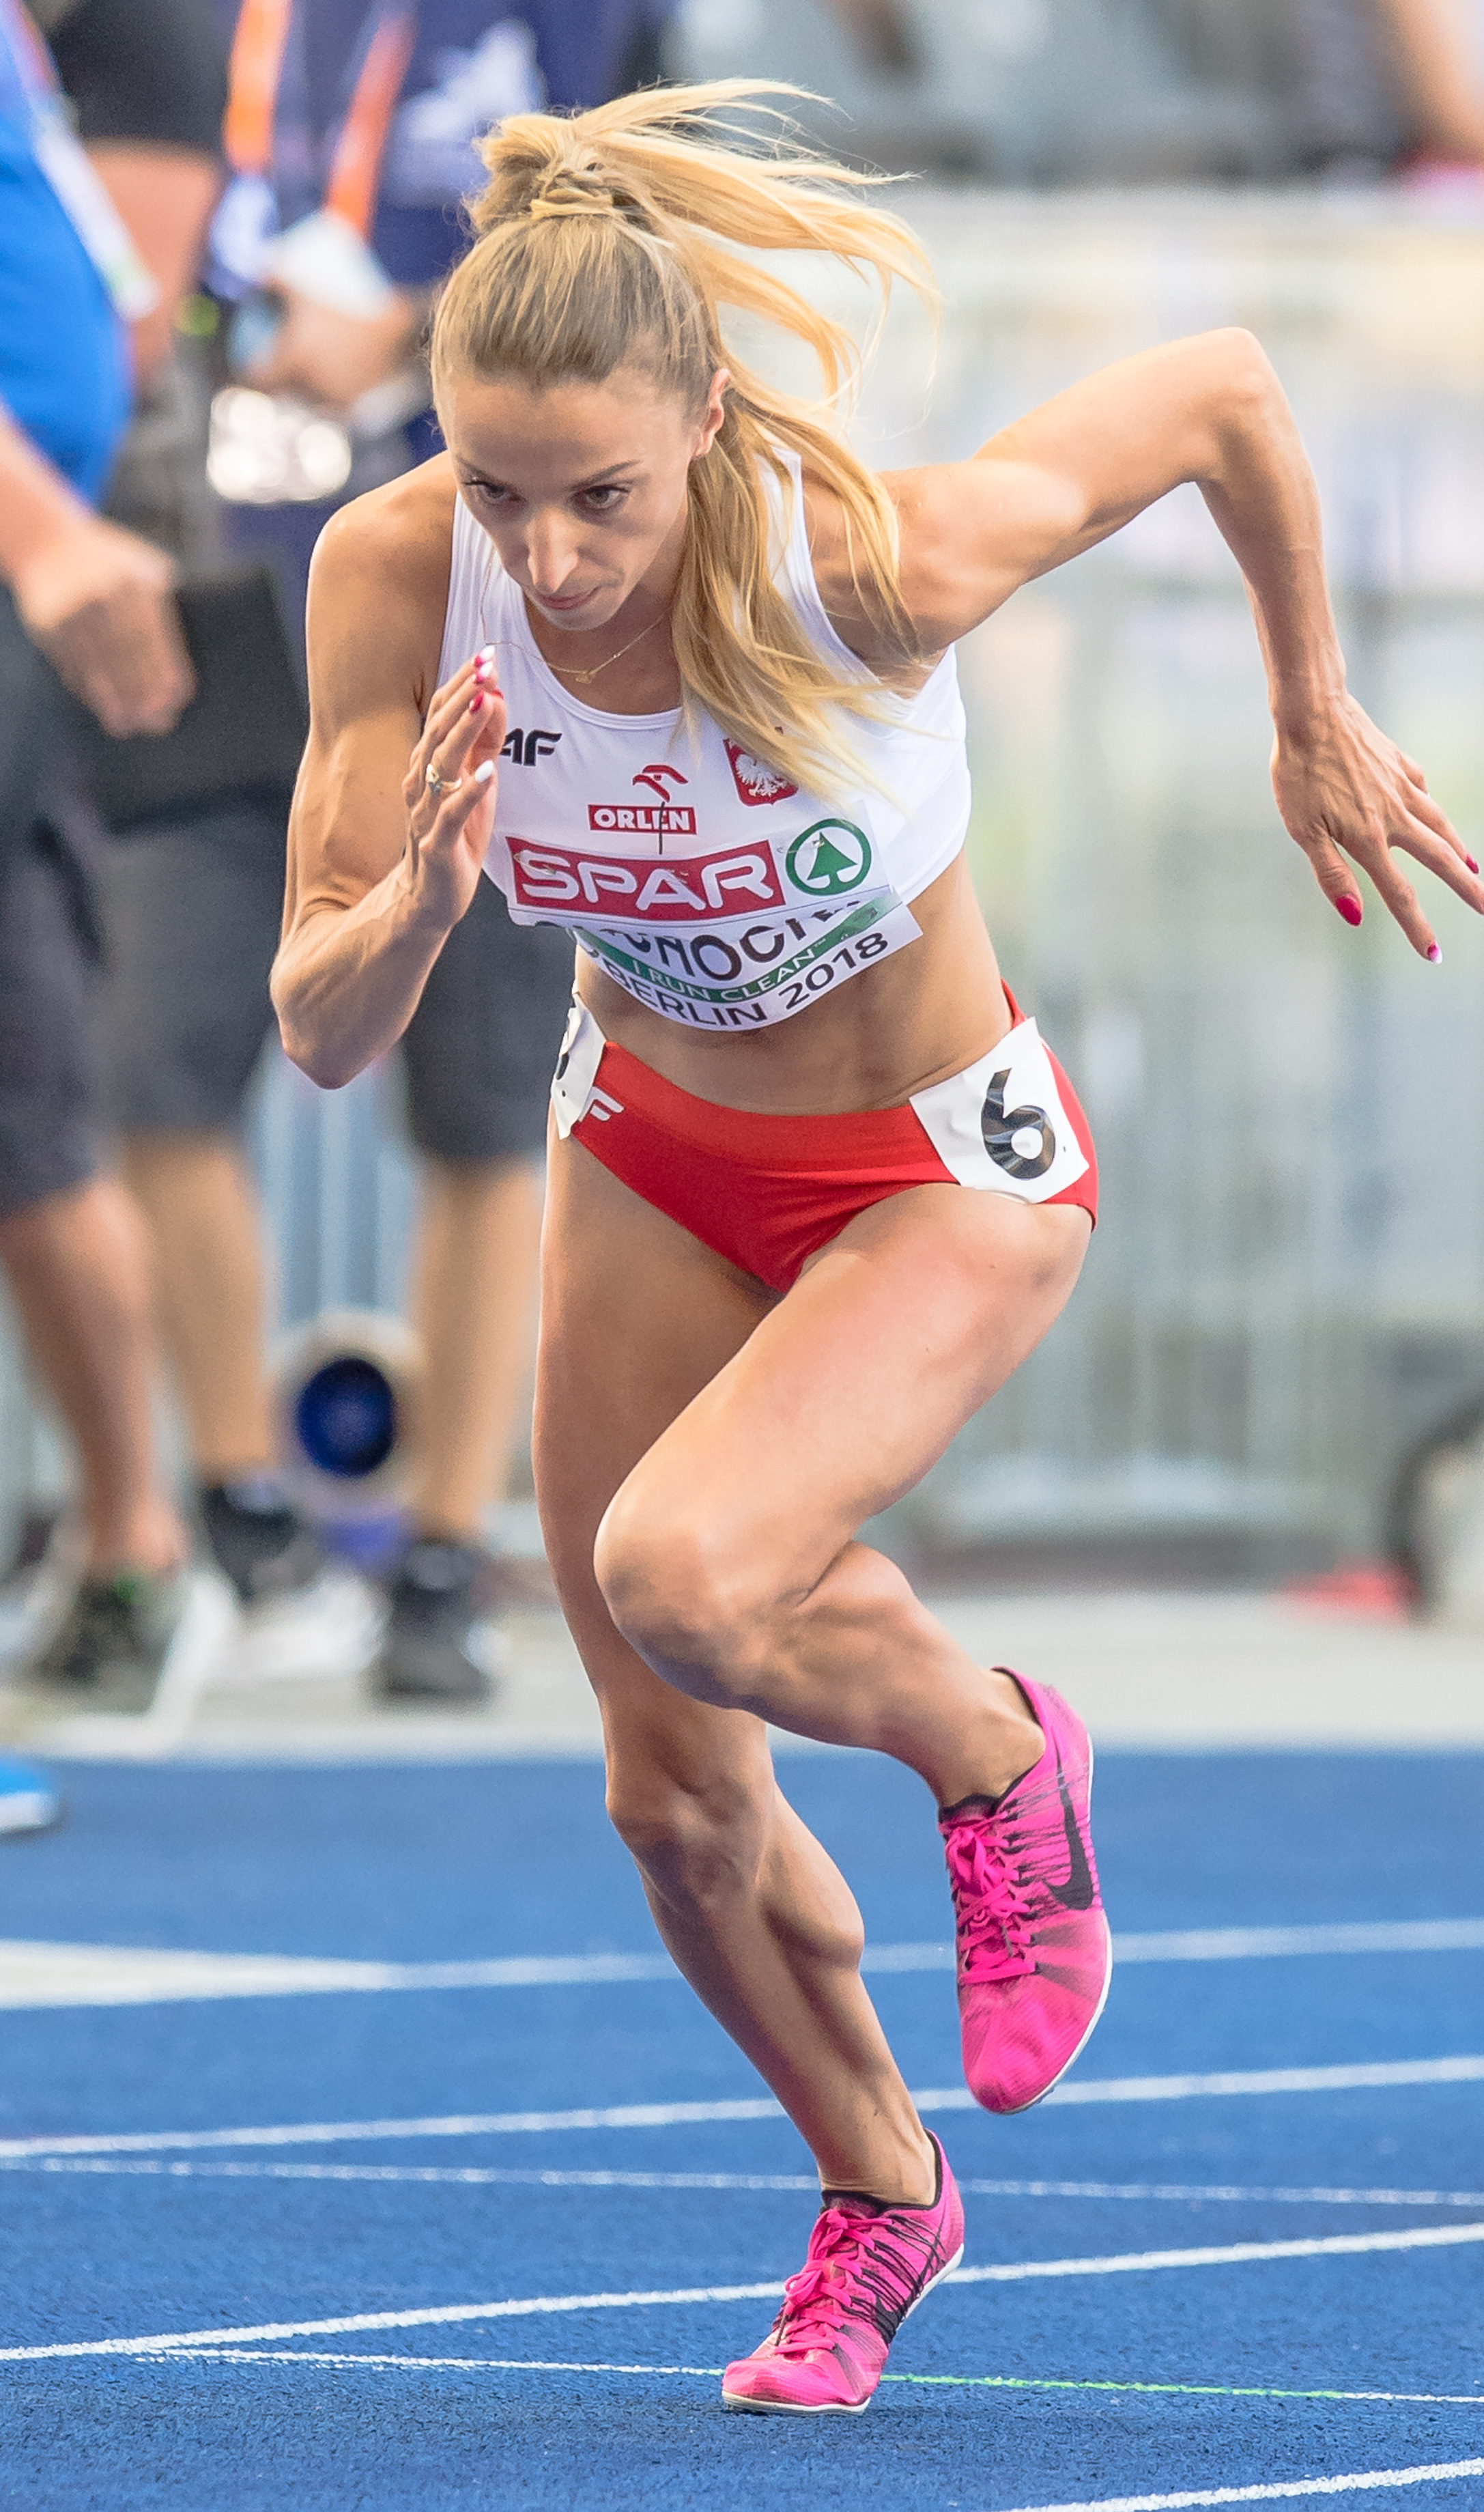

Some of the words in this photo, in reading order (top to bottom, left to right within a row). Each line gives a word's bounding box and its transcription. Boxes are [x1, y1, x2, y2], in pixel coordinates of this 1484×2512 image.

[593, 808, 690, 830] ORLEN
[520, 849, 774, 911] SPAR
[601, 957, 768, 1026] BERLIN
[778, 932, 888, 1010] 2018
[632, 959, 640, 975] I
[648, 968, 711, 1000] RUN
[721, 948, 815, 1002] CLEAN
[981, 1067, 1056, 1181] 6
